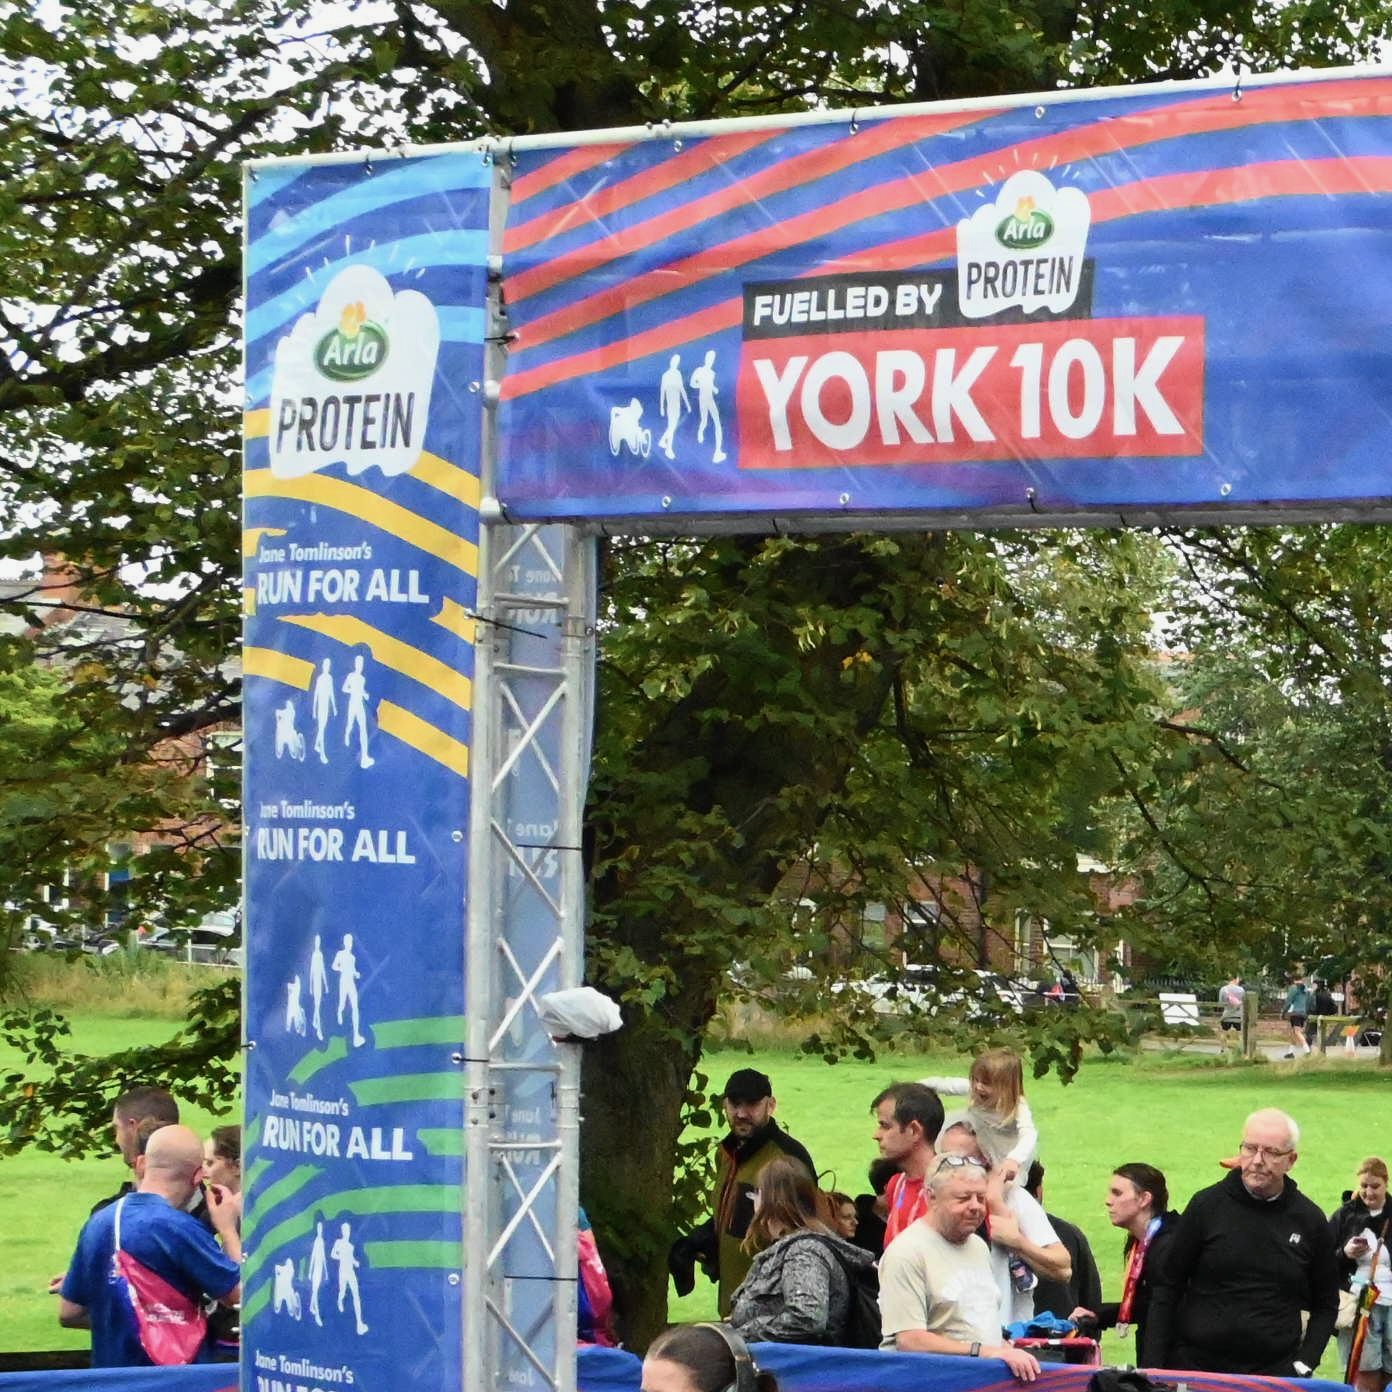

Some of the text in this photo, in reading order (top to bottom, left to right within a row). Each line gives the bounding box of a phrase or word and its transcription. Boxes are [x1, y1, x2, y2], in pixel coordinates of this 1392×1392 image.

[1003, 219, 1045, 241] Arla
[966, 256, 1073, 299] PROTEIN
[753, 283, 943, 326] FUELLED BY
[323, 334, 377, 366] Arla
[752, 335, 1185, 452] YORK 10K
[275, 391, 414, 453] PROTEIN
[258, 541, 372, 563] Jane Tomlinson's
[257, 569, 429, 605] RUN FOR ALL
[280, 800, 355, 819] Tomlinson's
[297, 829, 343, 863] FOR
[351, 829, 415, 864] ALL
[262, 1115, 413, 1161] RUN FOR ALL
[255, 1350, 354, 1384] Jane Tomlinson's
